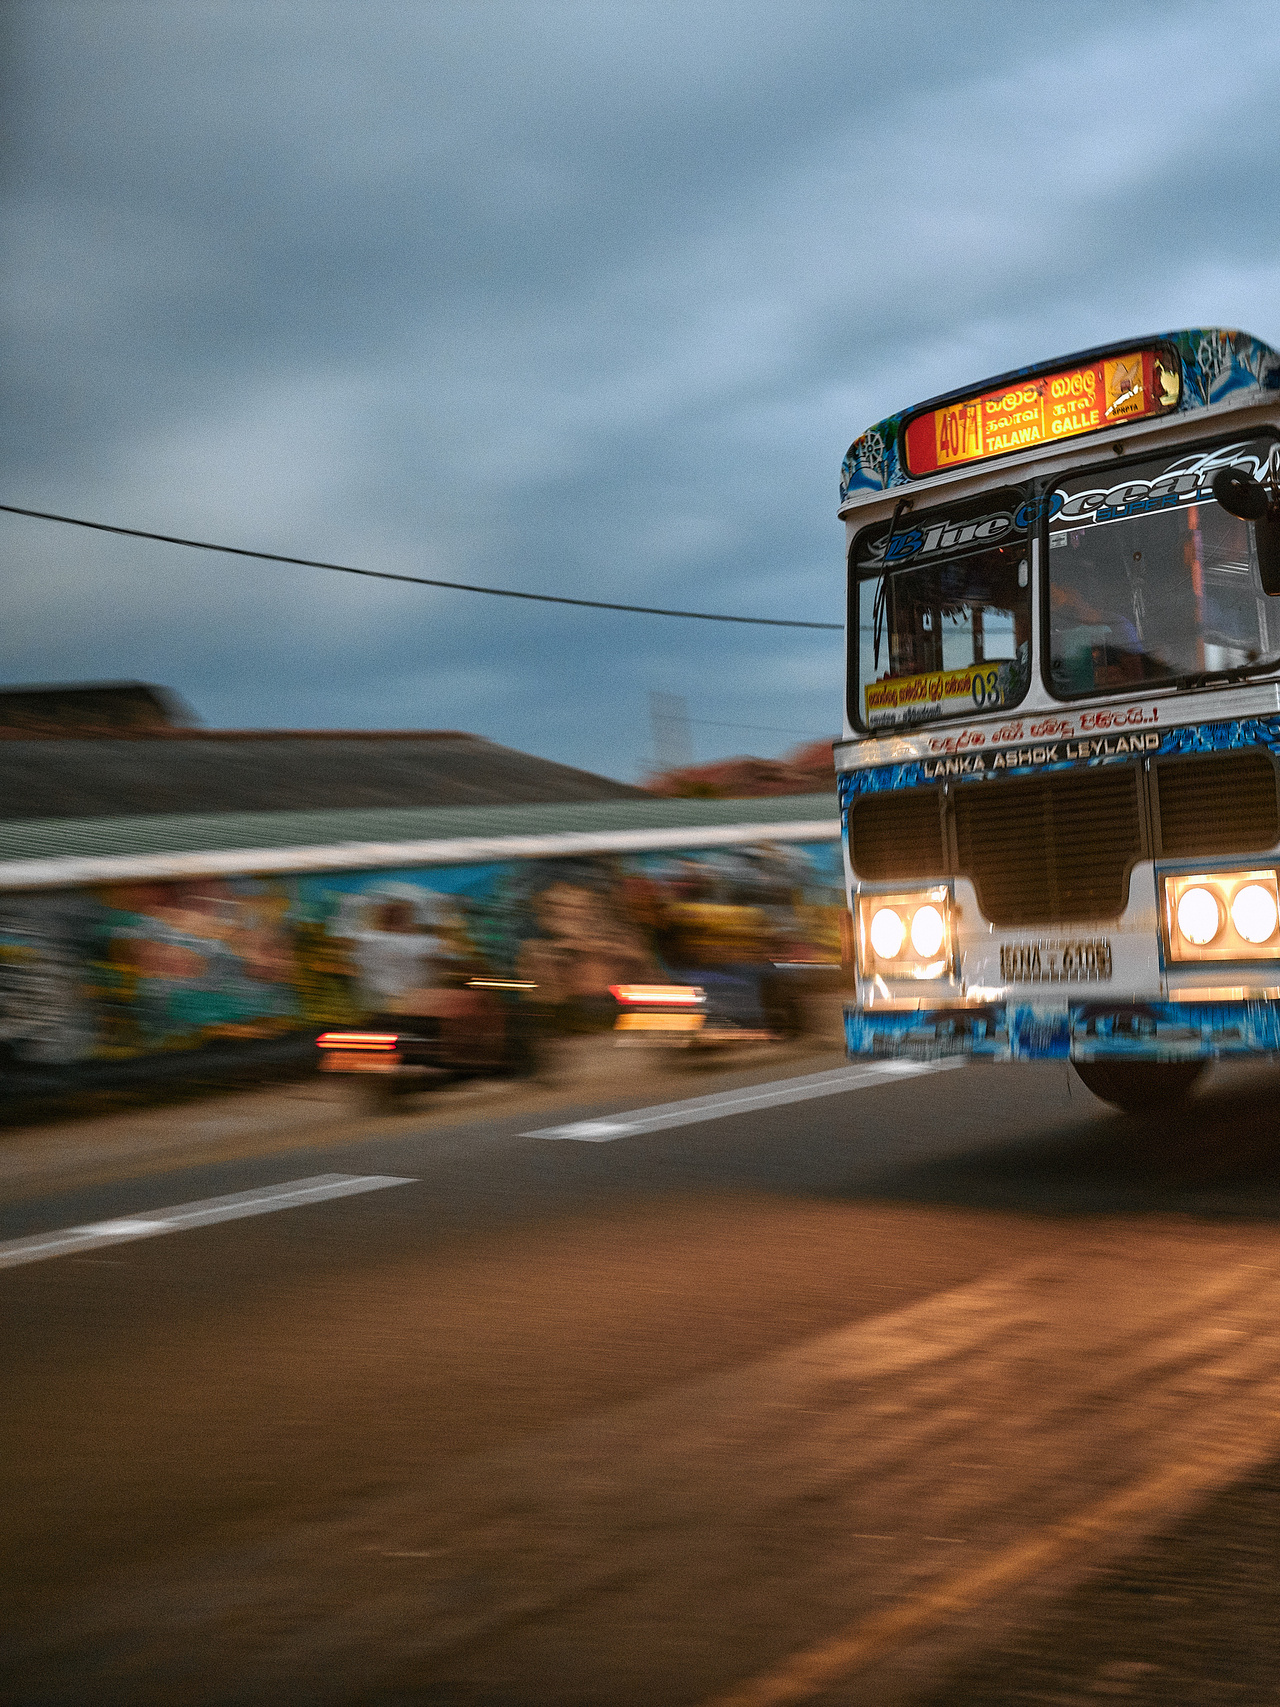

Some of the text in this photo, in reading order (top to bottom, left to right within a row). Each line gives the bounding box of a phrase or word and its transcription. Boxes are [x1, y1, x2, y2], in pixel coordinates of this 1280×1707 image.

[1051, 410, 1100, 435] GALLE
[986, 425, 1041, 452] TALAWA
[1096, 494, 1178, 522] SUPER
[885, 518, 1010, 561] Blue
[924, 731, 1160, 778] LANKA ASHOK LEYLAND
